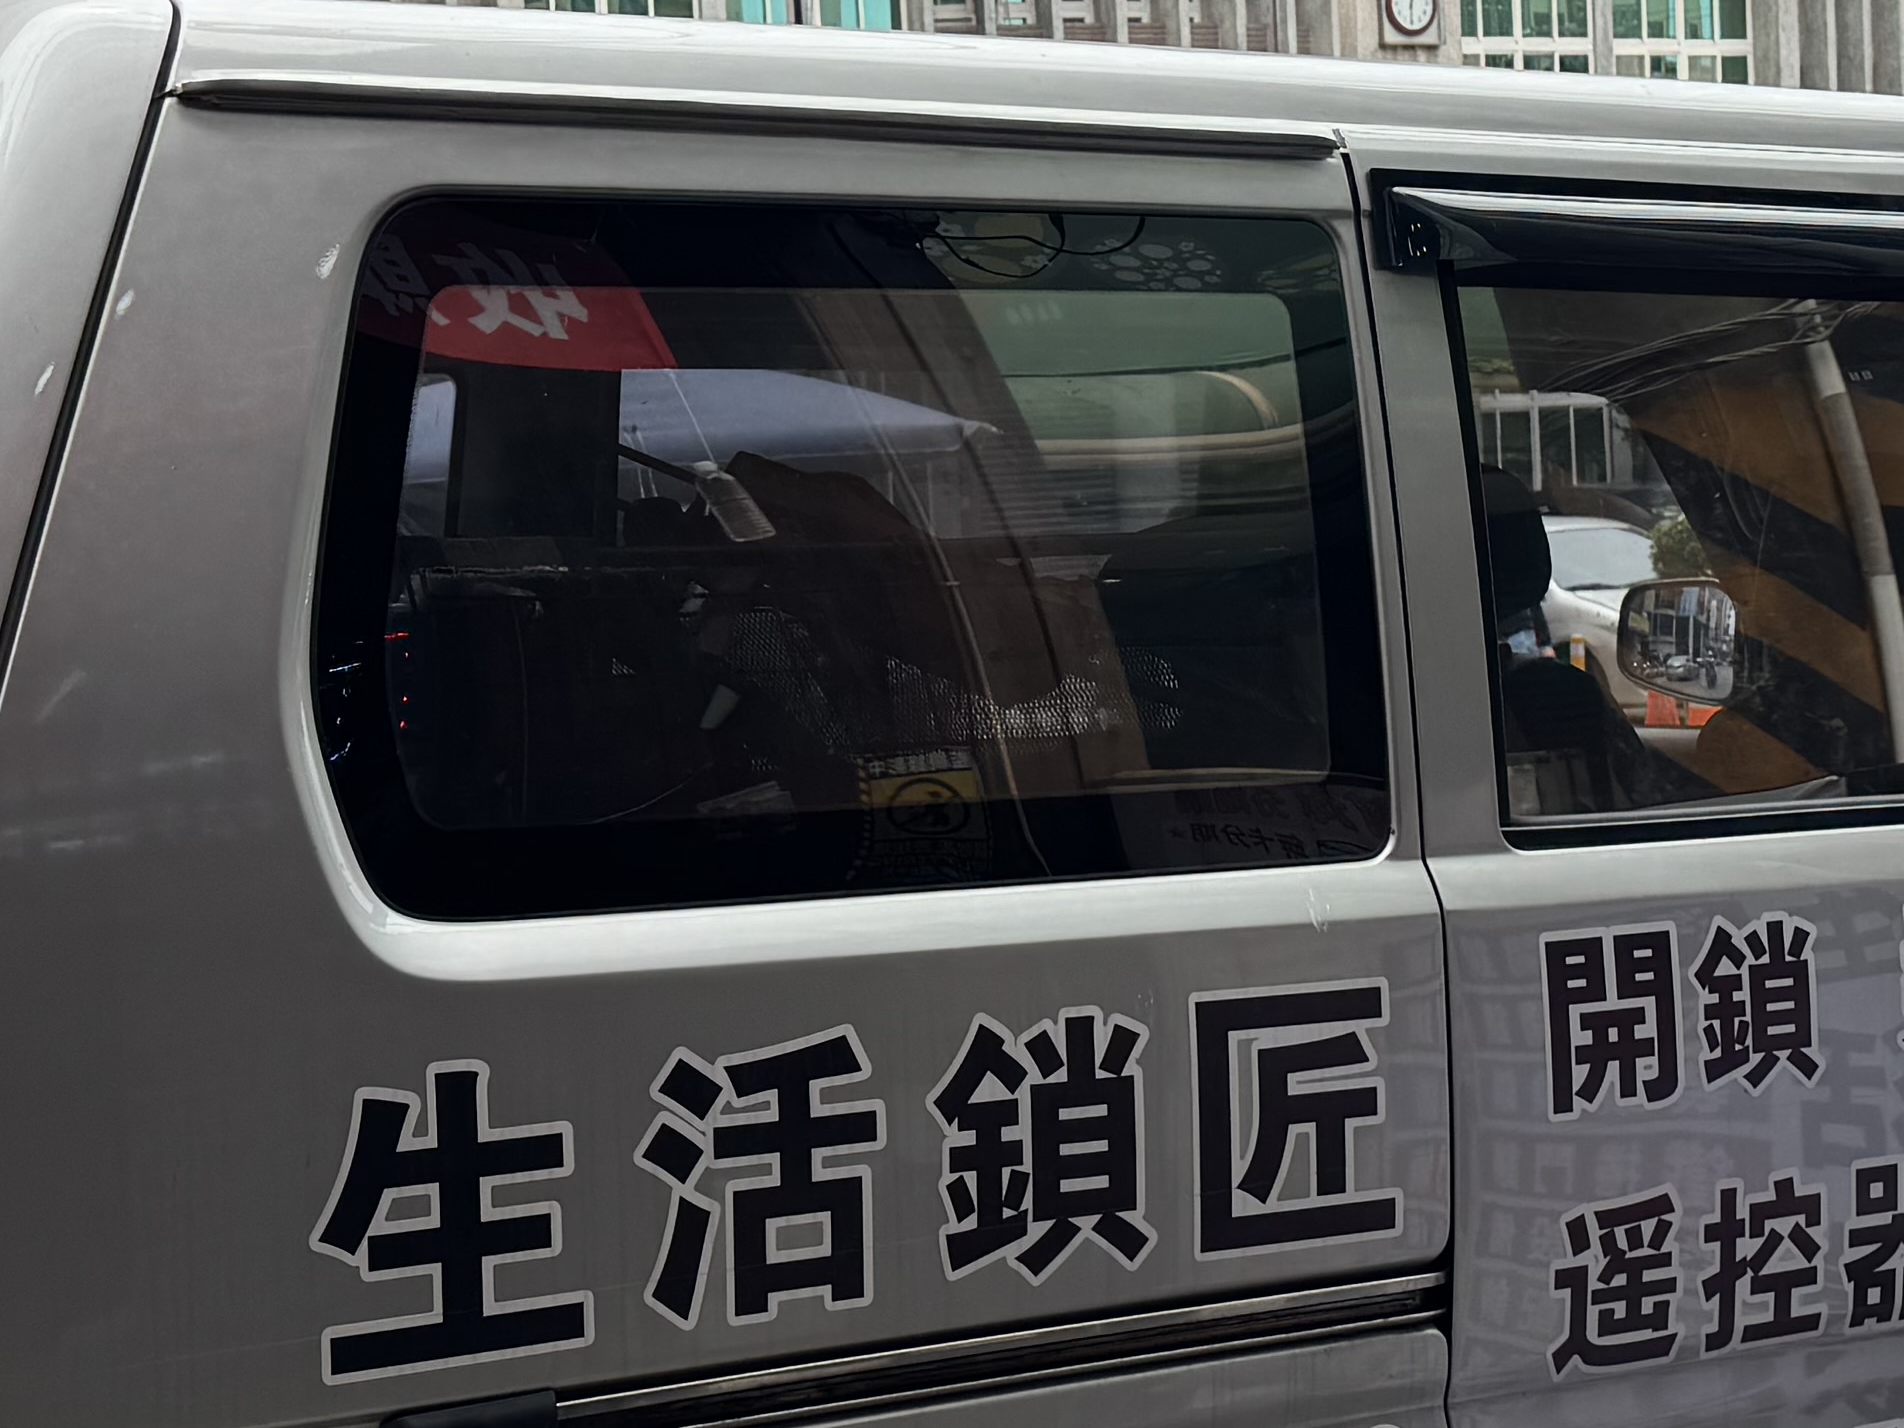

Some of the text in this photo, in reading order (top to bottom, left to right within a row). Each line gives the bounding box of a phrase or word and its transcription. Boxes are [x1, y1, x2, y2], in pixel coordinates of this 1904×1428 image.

[1539, 908, 1823, 1122] 開鎖
[309, 976, 1404, 1385] 生活鎖匠
